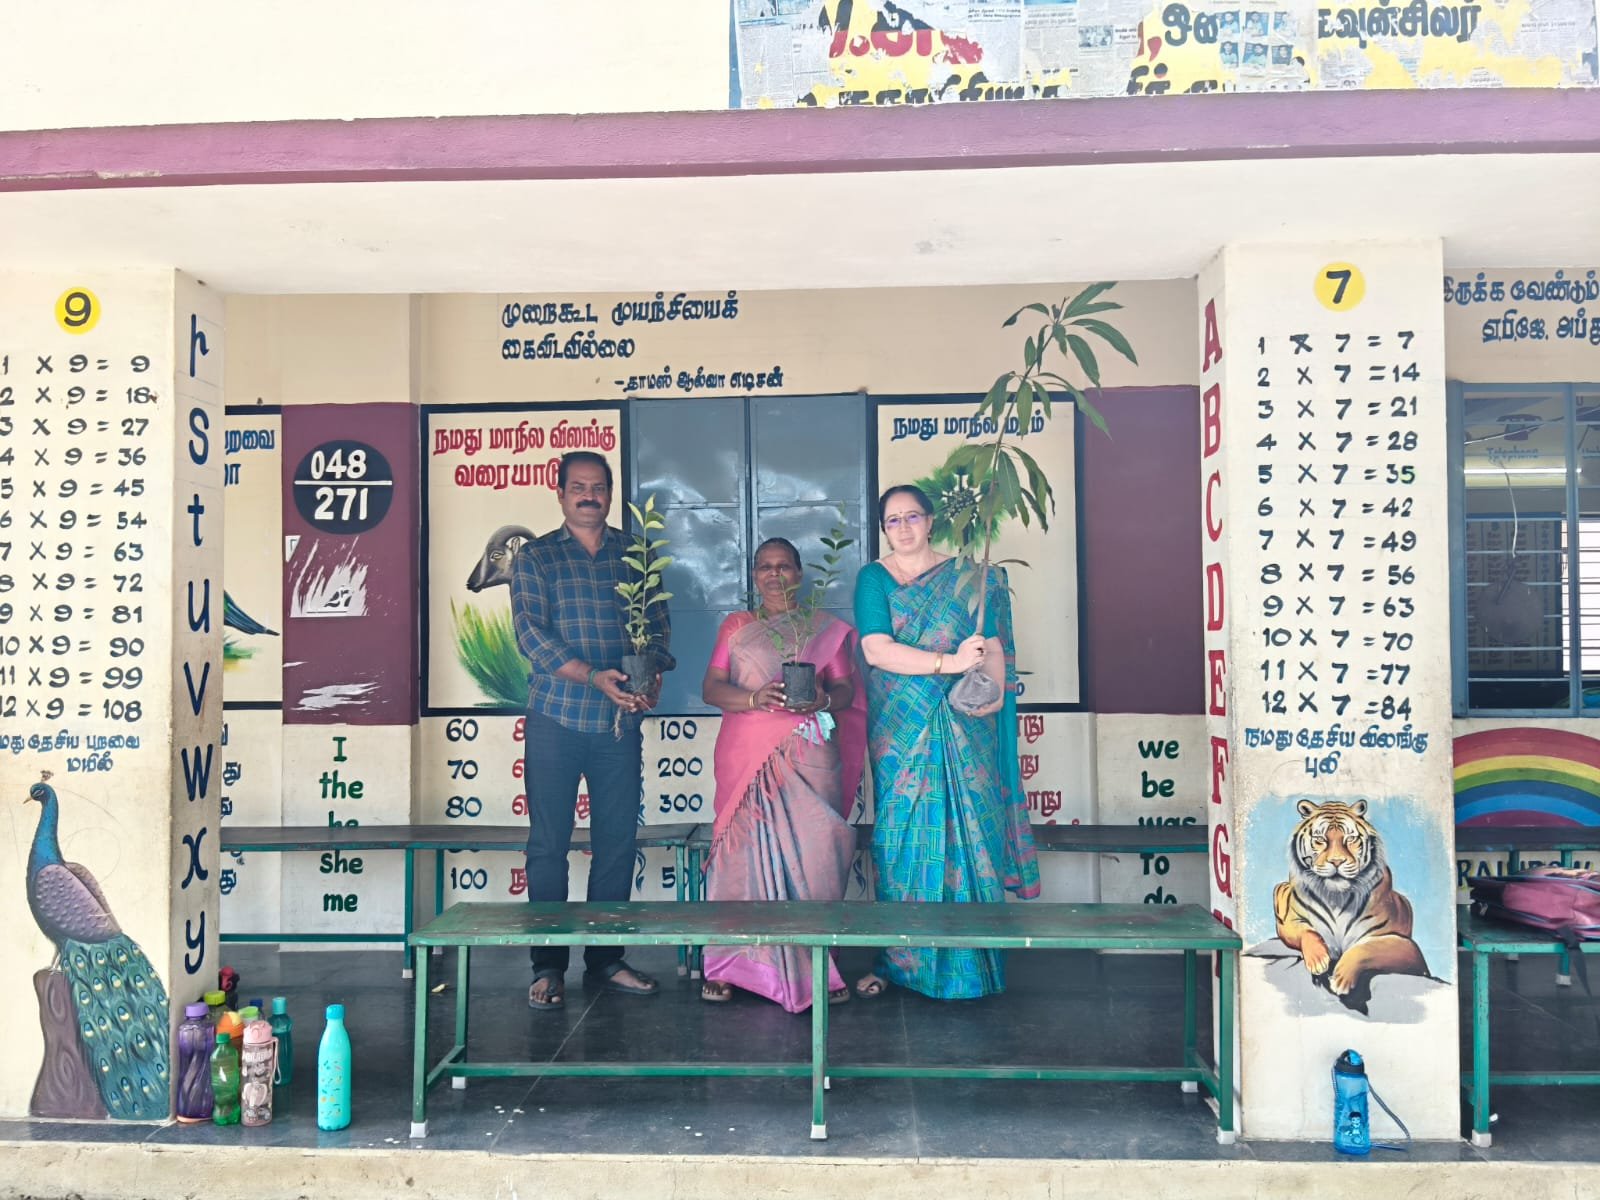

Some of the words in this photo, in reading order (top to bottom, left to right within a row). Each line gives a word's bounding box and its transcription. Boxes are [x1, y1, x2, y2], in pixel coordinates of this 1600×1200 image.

[1326, 270, 1352, 304] 7
[1510, 269, 1600, 304] வேண்டும்
[64, 291, 92, 327] 9
[502, 303, 598, 328] முறைகூட
[502, 330, 635, 360] கைவிடவில்லை
[1203, 298, 1222, 373] A
[1257, 336, 1265, 355] 1
[1336, 334, 1350, 352] 7
[1398, 331, 1414, 349] 7
[69, 355, 88, 372] 9
[131, 356, 150, 372] 9
[1258, 368, 1270, 387] 2
[1334, 365, 1351, 383] 7
[1393, 362, 1420, 382] 14
[676, 366, 726, 392] ஆல்வா
[68, 386, 85, 404] 9
[126, 387, 151, 403] 18
[1203, 382, 1221, 458] B
[1258, 400, 1273, 419] 3
[1336, 399, 1352, 420] 7
[1391, 396, 1416, 417] 21
[68, 418, 87, 435] 9
[121, 418, 149, 436] 27
[433, 428, 482, 456] நமது
[489, 420, 545, 455] மாநில
[550, 418, 616, 451] விலங்கு
[891, 417, 938, 441] நமது
[1004, 409, 1044, 436] மம்
[1256, 434, 1277, 451] 4
[1336, 432, 1352, 453] 7
[1388, 431, 1418, 451] 28
[64, 448, 82, 465] 9
[118, 447, 146, 466] 36
[311, 449, 367, 479] 048
[1258, 464, 1272, 484] 5
[1333, 464, 1348, 485] 7
[1386, 464, 1415, 484] 35
[59, 479, 77, 498] 9
[114, 479, 144, 496] 45
[314, 487, 369, 520] 271
[1206, 470, 1223, 542] C
[1258, 497, 1273, 516] 6
[1332, 499, 1346, 519] 7
[1383, 497, 1413, 517] 42
[59, 510, 76, 529] 9
[117, 512, 147, 529] 54
[187, 494, 205, 546] t
[56, 543, 72, 560] 9
[114, 542, 143, 562] 63
[1259, 530, 1273, 550] 7
[1329, 529, 1344, 550] 7
[1381, 531, 1416, 552] 49
[56, 573, 75, 591] 9
[113, 573, 143, 592] 72
[1261, 564, 1282, 584] 8
[1327, 564, 1344, 581] 7
[1388, 565, 1415, 585] 56
[188, 579, 210, 633] u
[1206, 562, 1224, 631] D
[1263, 595, 1283, 617] 9
[1329, 596, 1345, 615] 7
[1383, 597, 1414, 618] 63
[54, 605, 72, 622] 9
[112, 605, 142, 623] 81
[52, 635, 70, 655] 9
[110, 637, 144, 657] 90
[1263, 628, 1292, 647] 10
[1331, 629, 1349, 648] 7
[1383, 631, 1413, 651] 70
[49, 667, 69, 688] 9
[102, 667, 142, 689] 99
[1261, 659, 1285, 681] 11
[1332, 663, 1348, 683] 7
[1208, 650, 1227, 717] E
[46, 698, 64, 720] 9
[104, 699, 142, 722] 108
[1262, 690, 1287, 714] 12
[1332, 694, 1351, 716] 7
[0, 732, 24, 754] மது
[28, 729, 79, 753] தேசிய
[446, 718, 479, 742] 60
[660, 720, 697, 740] 100
[1245, 727, 1293, 751] நமது
[1296, 723, 1355, 749] தேசிய
[1359, 724, 1428, 754] விலங்கு
[332, 737, 347, 762] I
[1138, 740, 1180, 759] we
[447, 759, 478, 780] 70
[658, 757, 703, 778] 200
[1211, 736, 1229, 804] F
[1305, 751, 1341, 778] புலி
[319, 770, 363, 799] the
[1141, 770, 1175, 798] be
[445, 795, 482, 818] 80
[659, 793, 703, 813] 300
[1213, 823, 1232, 898] G
[450, 867, 488, 889] 100
[323, 893, 358, 912] me
[184, 911, 206, 975] y
